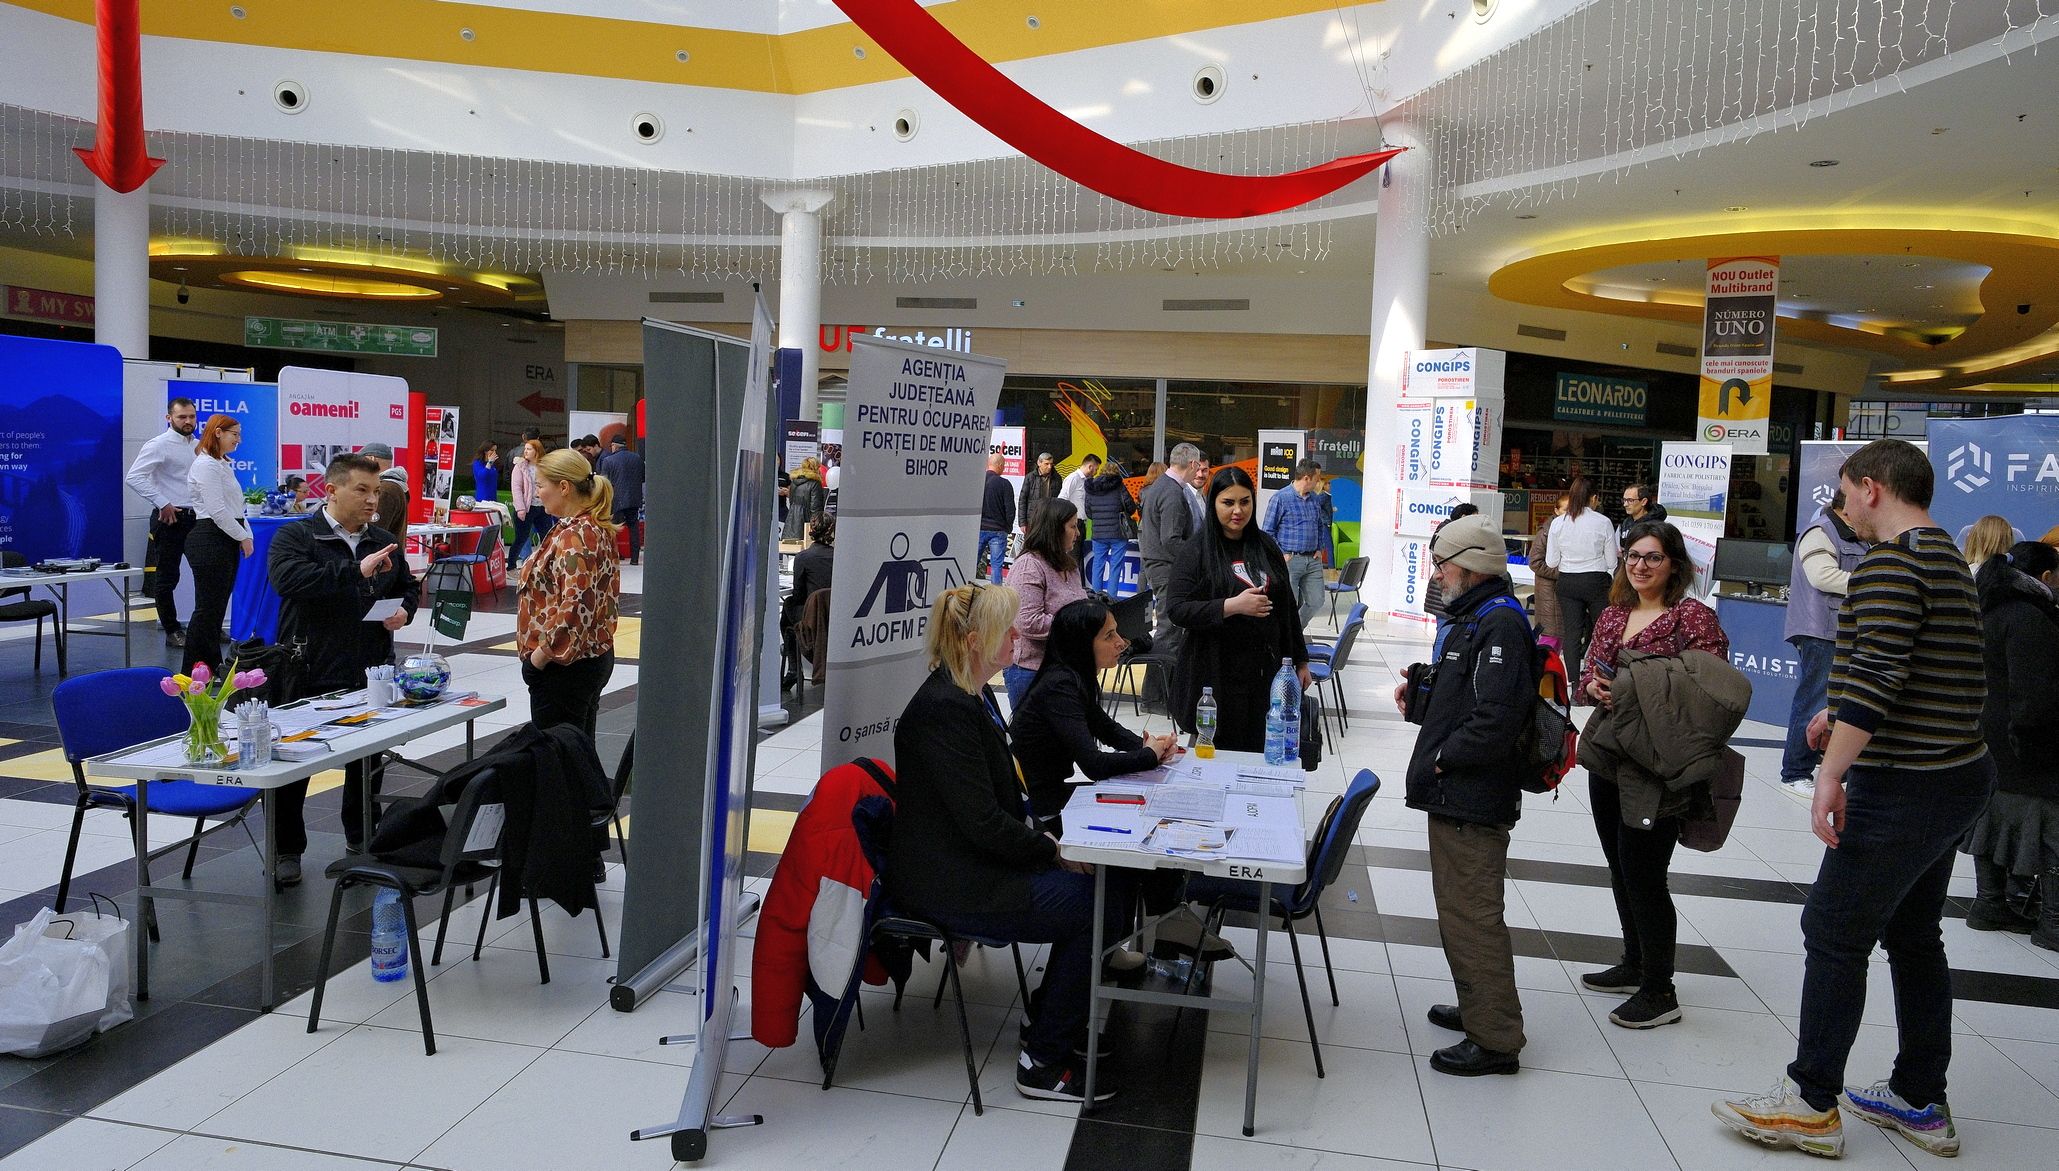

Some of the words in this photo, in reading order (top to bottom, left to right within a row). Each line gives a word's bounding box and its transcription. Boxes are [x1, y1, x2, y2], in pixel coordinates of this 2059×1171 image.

[1712, 271, 1736, 281] NOU
[1738, 269, 1774, 280] Outlet
[1711, 281, 1773, 294] Multibrand
[41, 297, 67, 315] MY
[1714, 309, 1765, 320] NÚMERO
[315, 326, 336, 337] ATM
[1714, 319, 1765, 336] UNO
[526, 364, 555, 381] ERA
[1416, 361, 1471, 373] CONGIPS
[1706, 367, 1736, 375] branduri
[1558, 378, 1646, 408] LEONARDO
[289, 400, 360, 419] oameni!
[391, 407, 402, 416] PGS
[857, 404, 918, 426] PENTRU
[922, 410, 991, 431] OCUPAREA
[6, 431, 15, 439] of
[1431, 406, 1445, 470] CONGIPS
[1471, 406, 1483, 472] CONGIPS
[1727, 429, 1761, 438] ERA
[920, 434, 937, 452] DE
[940, 436, 986, 454] MUNCĂ
[1319, 439, 1360, 452] fratelli
[1409, 418, 1422, 481] CONGIPS
[11, 452, 23, 460] for
[1664, 454, 1727, 470] CONGIPS
[11, 464, 28, 472] way
[905, 458, 948, 476] BIHOR
[1405, 542, 1418, 604] CONGIPS
[850, 618, 914, 648] AJOFM
[1734, 652, 1798, 675] FAIST
[839, 726, 852, 742] O
[216, 775, 244, 786] ERA
[1229, 865, 1264, 879] ERA
